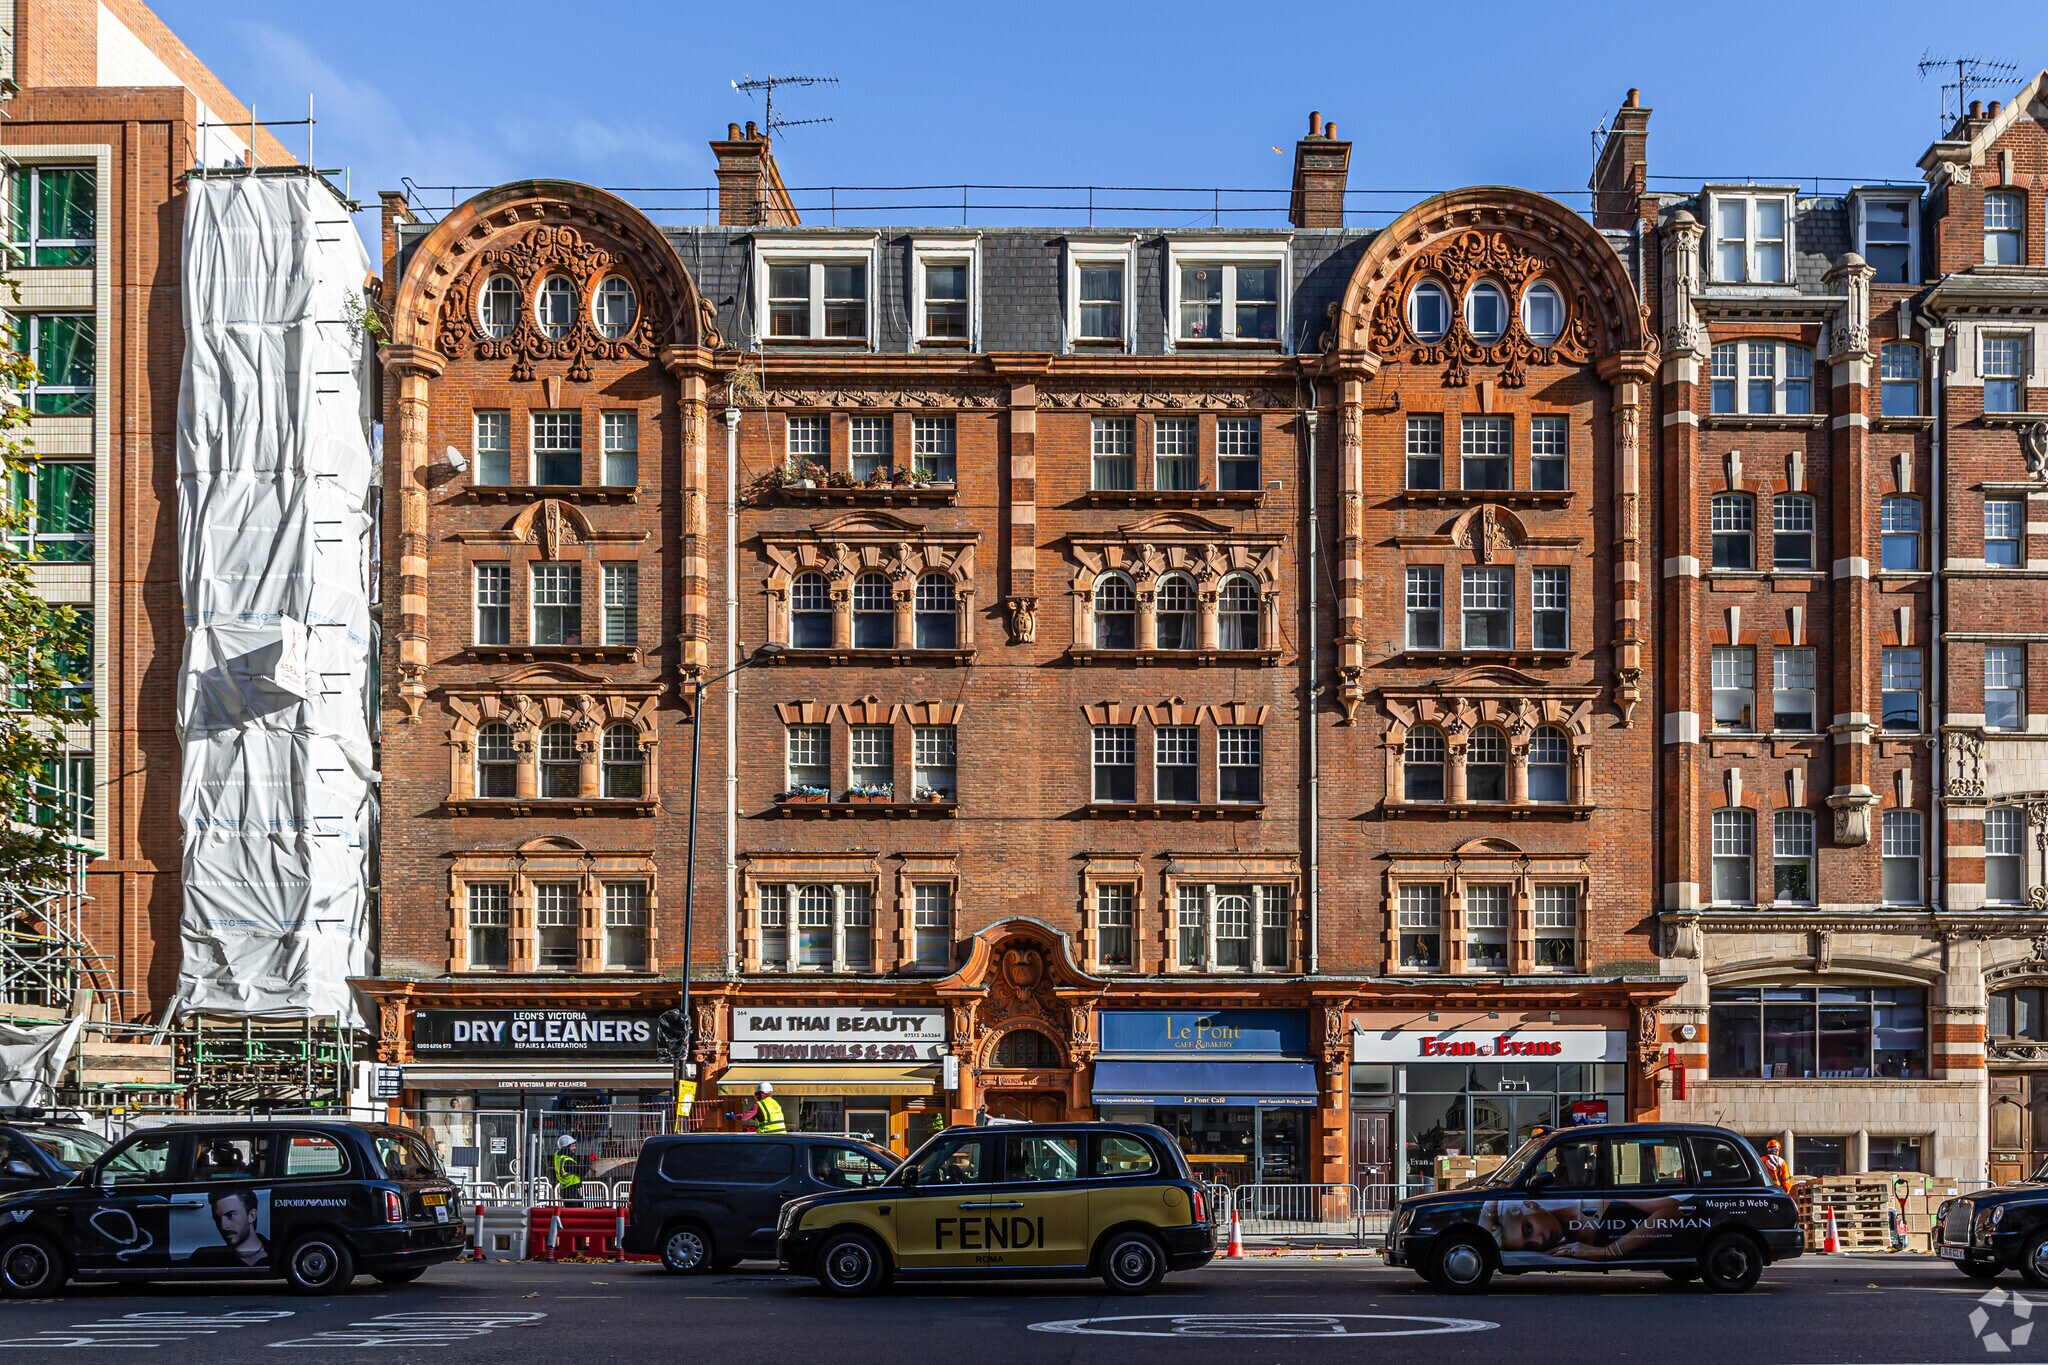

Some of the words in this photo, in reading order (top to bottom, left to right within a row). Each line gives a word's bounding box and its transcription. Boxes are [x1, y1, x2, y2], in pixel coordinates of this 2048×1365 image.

[513, 1012, 544, 1021] LEON'S
[547, 1012, 587, 1020] VICTORIA
[454, 1020, 506, 1042] DRY
[511, 1020, 650, 1042] CLEANERS
[750, 1016, 782, 1031] RAI
[786, 1016, 830, 1031] THAI
[836, 1017, 927, 1032] BEAUTY
[1166, 1016, 1192, 1039] Le
[1197, 1015, 1242, 1039] Pont
[811, 1044, 863, 1059] NAILS
[866, 1044, 880, 1059] &
[882, 1044, 918, 1059] SPA
[1195, 1040, 1205, 1050] &
[1420, 1036, 1477, 1056] Evan
[1497, 1035, 1563, 1056] Evans
[1410, 1158, 1429, 1166] Evan
[274, 1199, 308, 1207] EMPORIO
[318, 1198, 347, 1207] ARMANI
[1705, 1199, 1737, 1209] Mappin
[1739, 1199, 1745, 1207] &
[1746, 1199, 1769, 1207] Webb
[1568, 1219, 1626, 1231] DAVID
[1630, 1217, 1712, 1230] YURMAN
[935, 1216, 1044, 1250] FENDI
[975, 1255, 1004, 1263] ROMA
